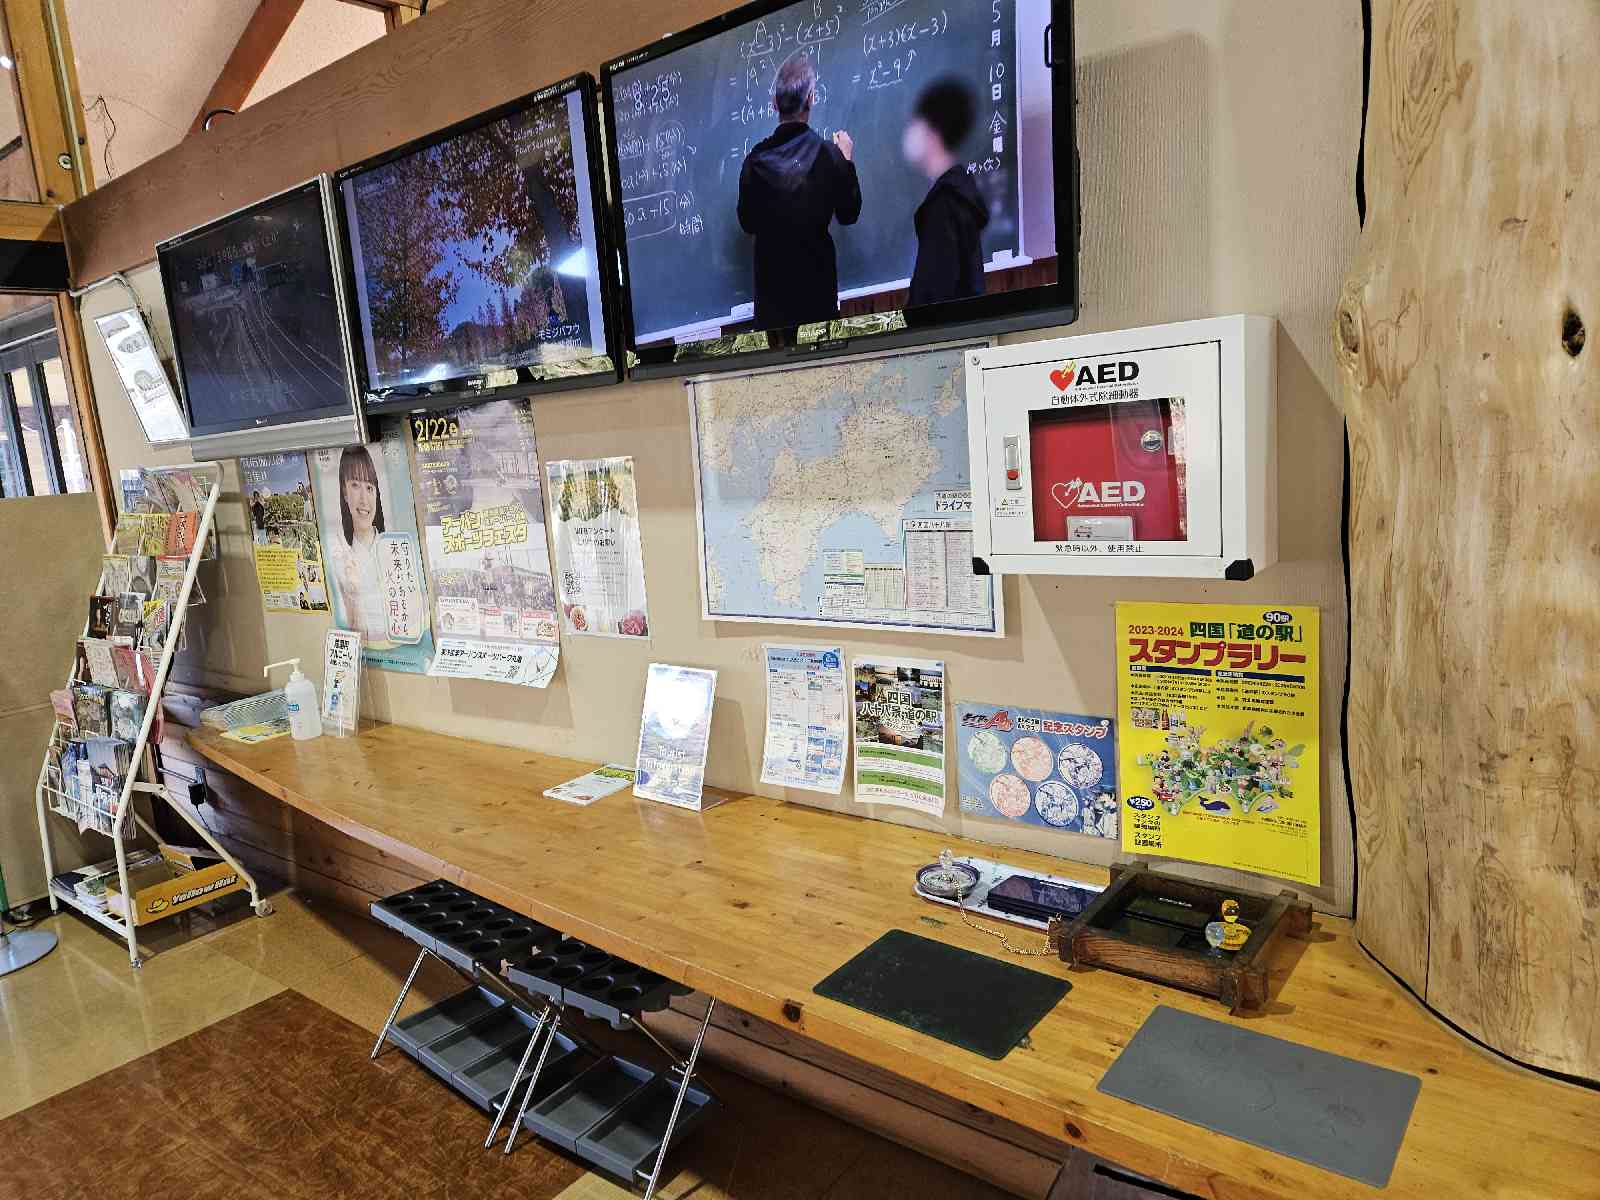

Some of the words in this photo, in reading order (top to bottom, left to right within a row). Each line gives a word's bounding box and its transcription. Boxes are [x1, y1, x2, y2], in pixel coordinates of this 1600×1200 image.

[1075, 361, 1140, 387] AED
[1051, 388, 1139, 406] 自動体外式除細動器
[1077, 480, 1146, 502] AED
[1128, 624, 1185, 637] 2023-2024
[1128, 638, 1307, 671] スタンプラリー
[887, 690, 911, 705] 四国
[1042, 718, 1108, 739] 記念スタンプ
